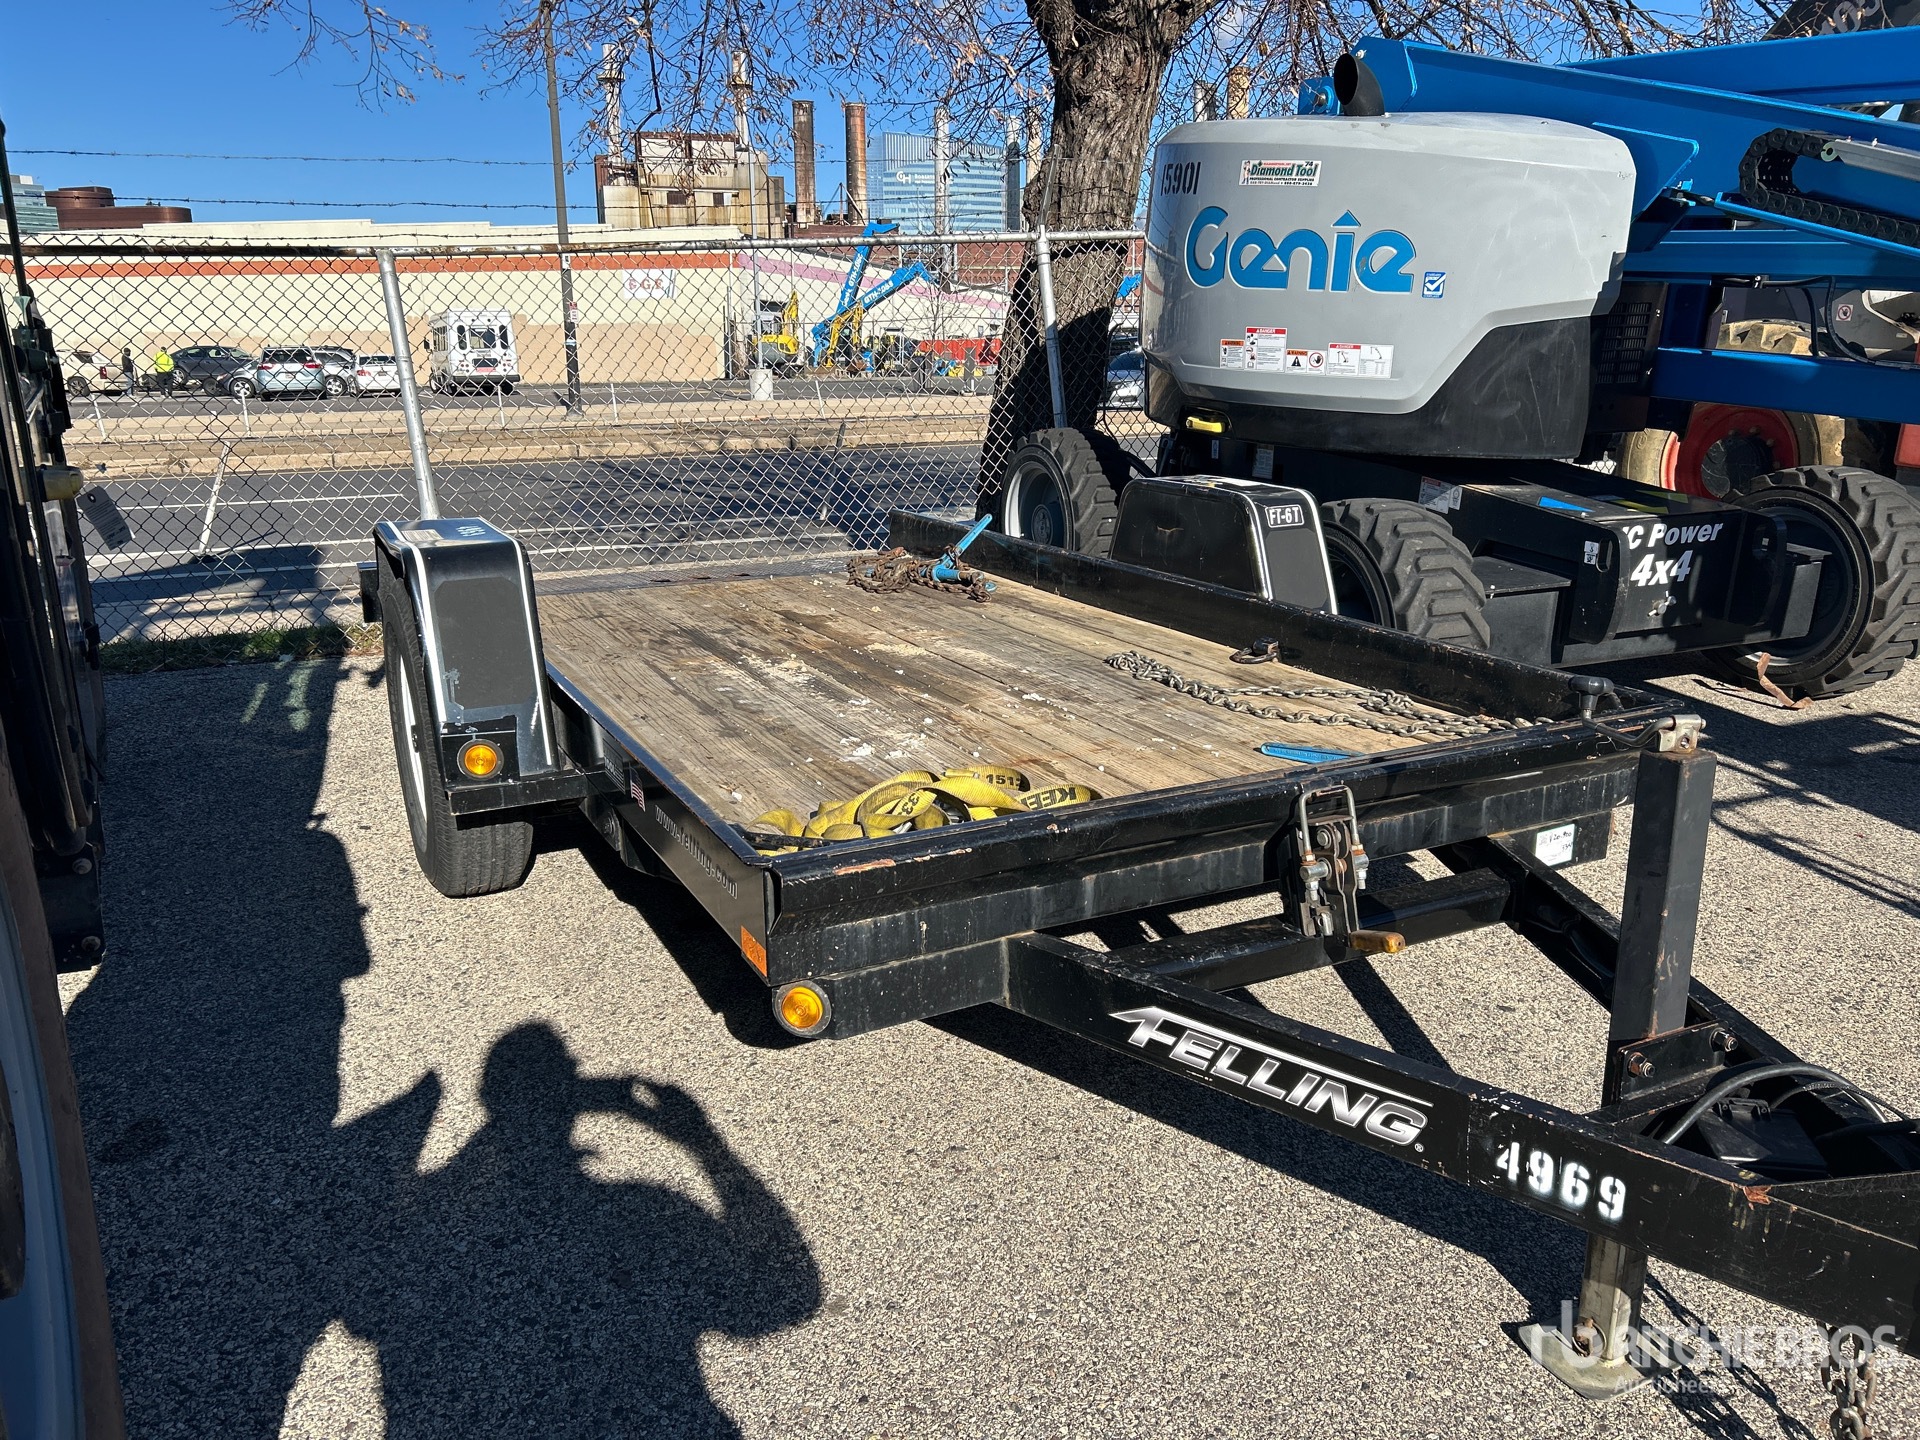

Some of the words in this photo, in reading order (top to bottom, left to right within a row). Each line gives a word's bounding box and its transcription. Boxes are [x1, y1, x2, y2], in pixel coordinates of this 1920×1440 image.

[1161, 162, 1201, 196] 15901
[1250, 163, 1296, 177] Diamond
[1295, 163, 1319, 177] Tool
[1184, 206, 1416, 294] Genie
[1268, 506, 1300, 526] FT-6T
[1622, 525, 1644, 550] C
[1648, 523, 1723, 548] Power
[1630, 550, 1694, 587] 4x4
[1020, 787, 1077, 811] KEE
[1110, 1006, 1433, 1146] FELLING
[1496, 1142, 1627, 1221] 4969
